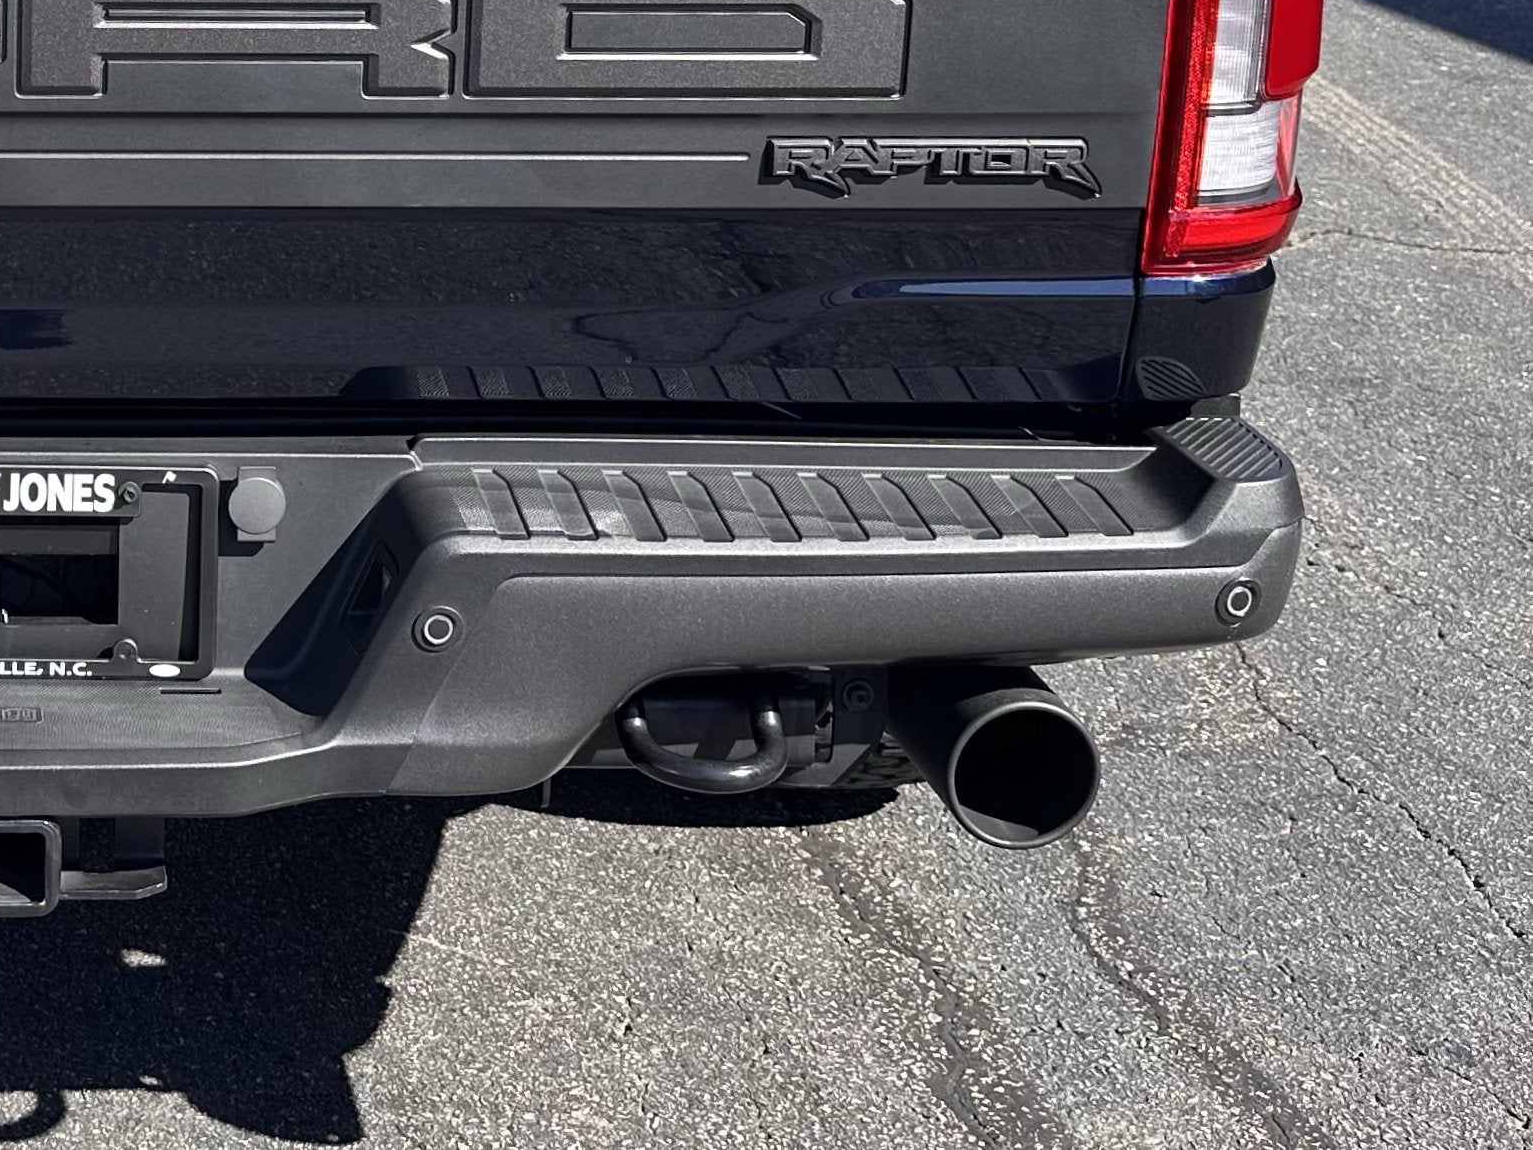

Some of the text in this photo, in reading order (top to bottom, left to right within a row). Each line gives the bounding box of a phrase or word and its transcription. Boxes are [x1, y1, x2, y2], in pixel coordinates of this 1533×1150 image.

[764, 136, 1103, 199] RAPTOR
[2, 472, 116, 513] JONES
[49, 661, 93, 677] N.C.
